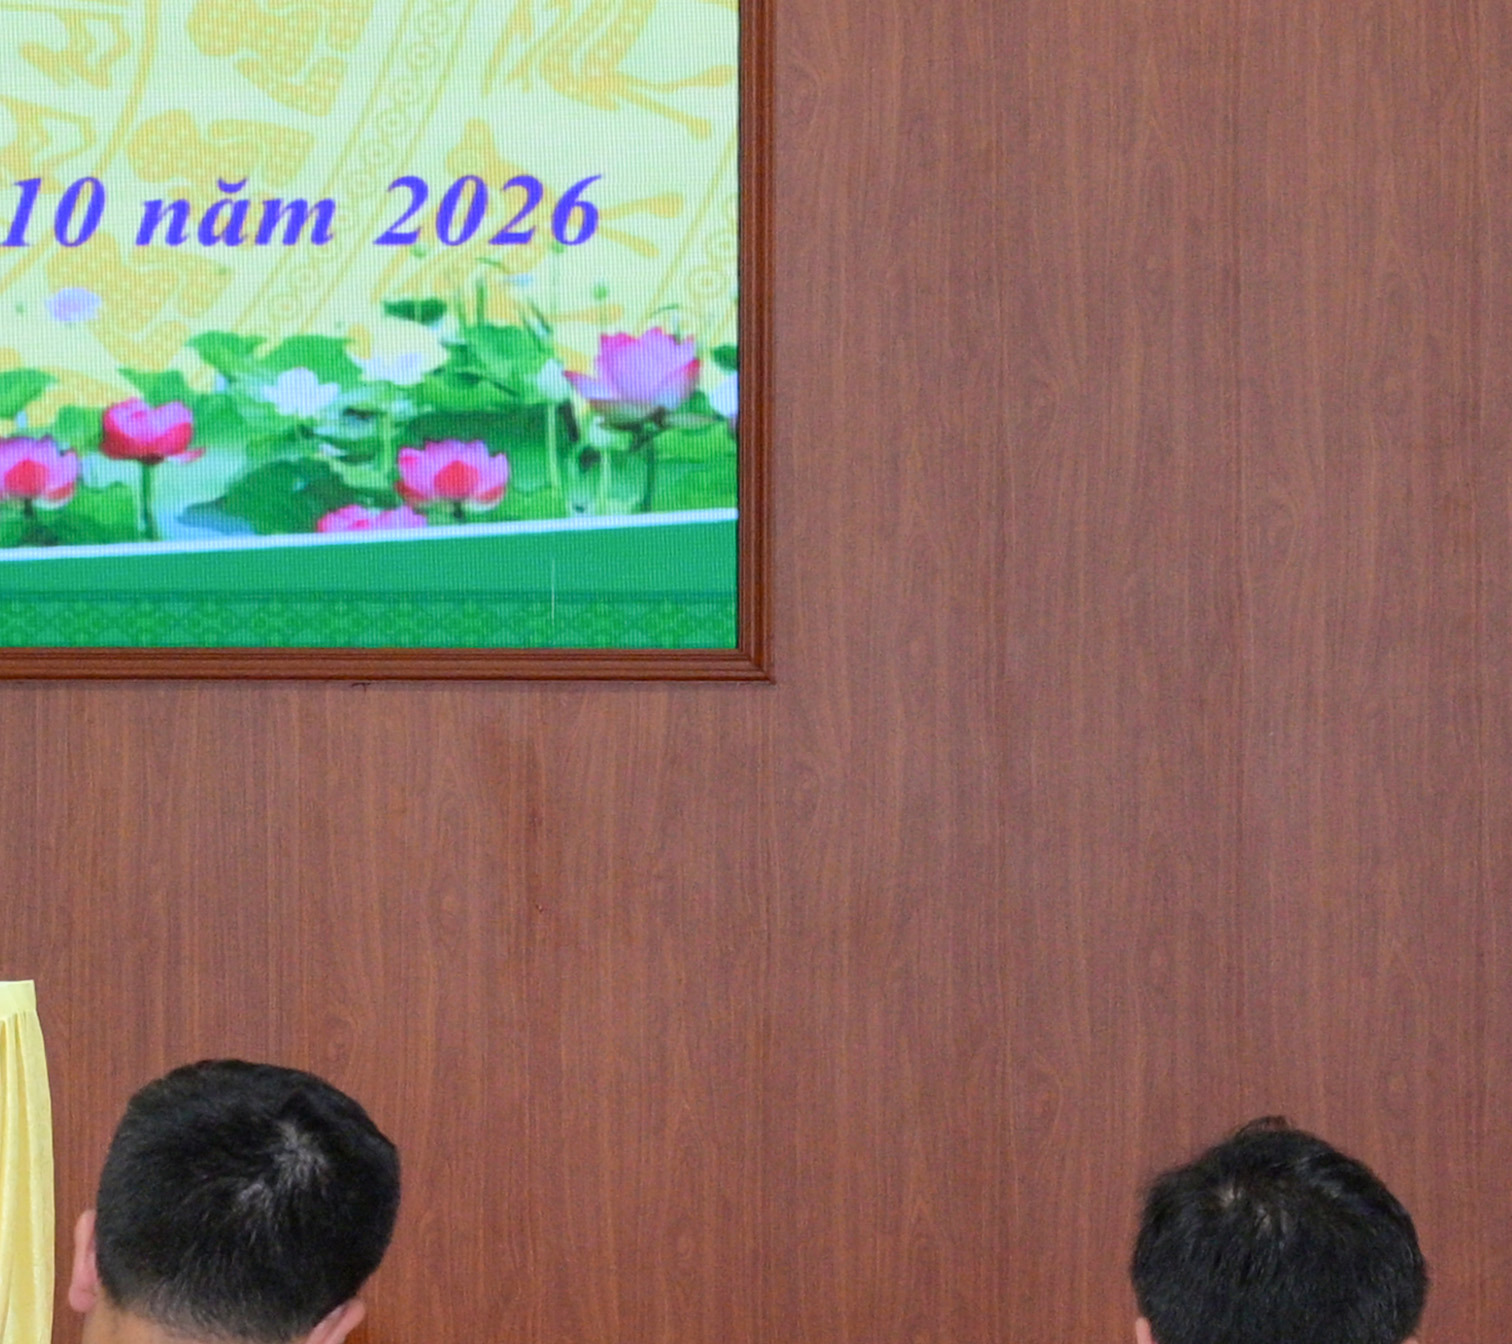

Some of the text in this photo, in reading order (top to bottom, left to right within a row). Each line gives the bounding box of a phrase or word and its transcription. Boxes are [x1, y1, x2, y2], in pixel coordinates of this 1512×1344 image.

[1, 176, 108, 248] 10
[134, 178, 338, 248] năm
[373, 173, 602, 248] 2026
